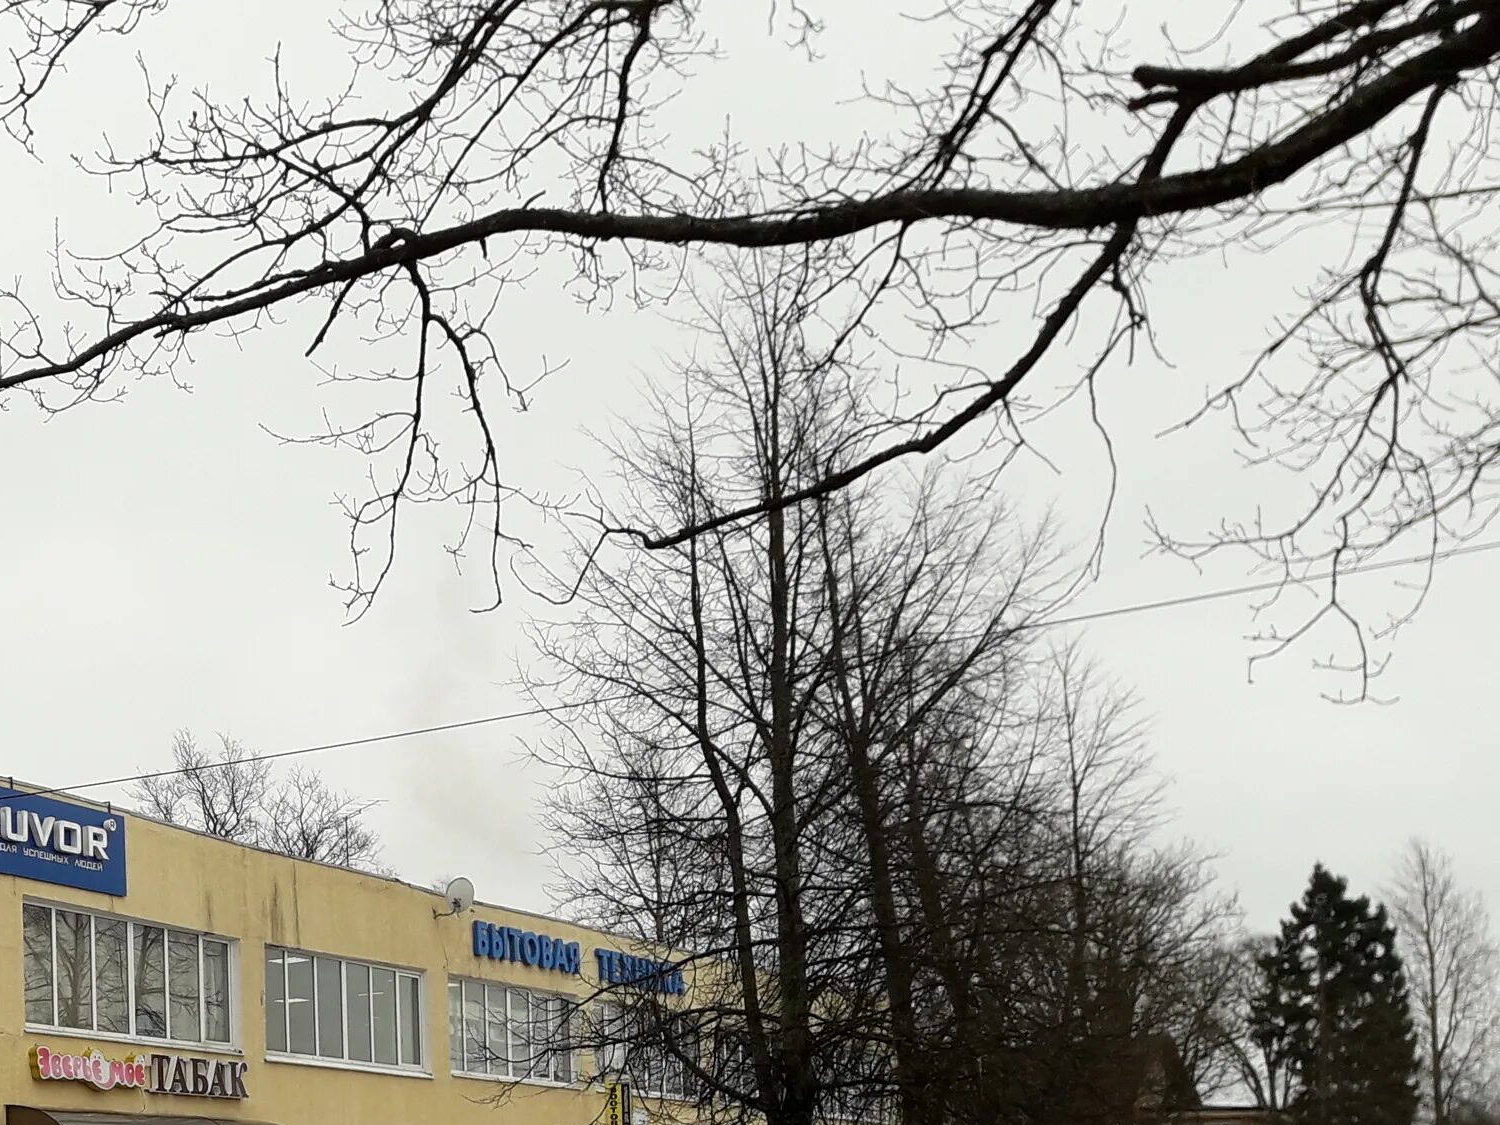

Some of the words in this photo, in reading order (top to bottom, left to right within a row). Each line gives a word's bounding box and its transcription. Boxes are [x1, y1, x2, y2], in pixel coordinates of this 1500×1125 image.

[22, 848, 69, 865] УСПЕШНЫХ
[74, 859, 104, 872] ЛЮДЕЙ
[473, 920, 580, 974] БЫТОВАЯ
[151, 1053, 249, 1098] ТАБАК
